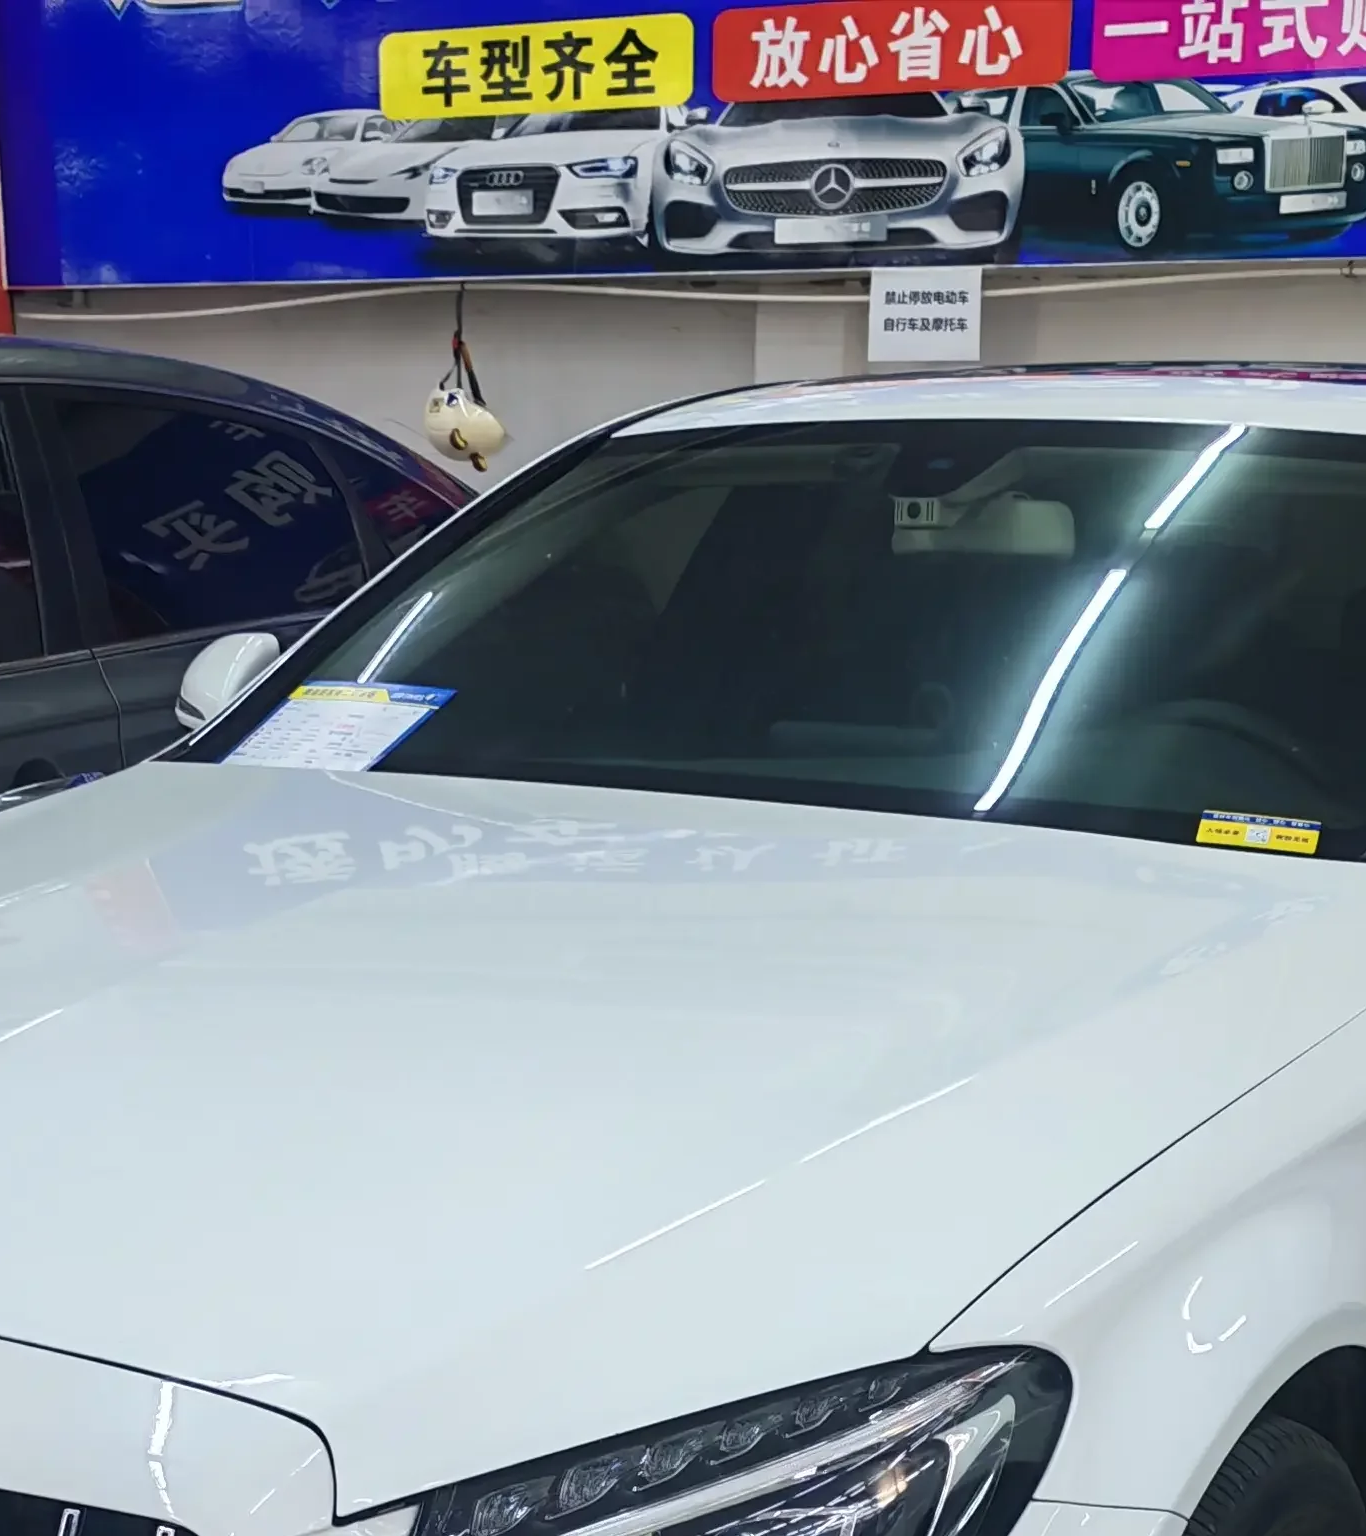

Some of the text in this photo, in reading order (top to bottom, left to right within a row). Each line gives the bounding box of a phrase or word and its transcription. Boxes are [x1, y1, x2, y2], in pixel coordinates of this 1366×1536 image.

[421, 28, 659, 107] 车型齐全
[750, 5, 1023, 88] 放心省心
[884, 290, 969, 305] 禁止停放电动车
[883, 317, 968, 332] 自行车及摩托车
